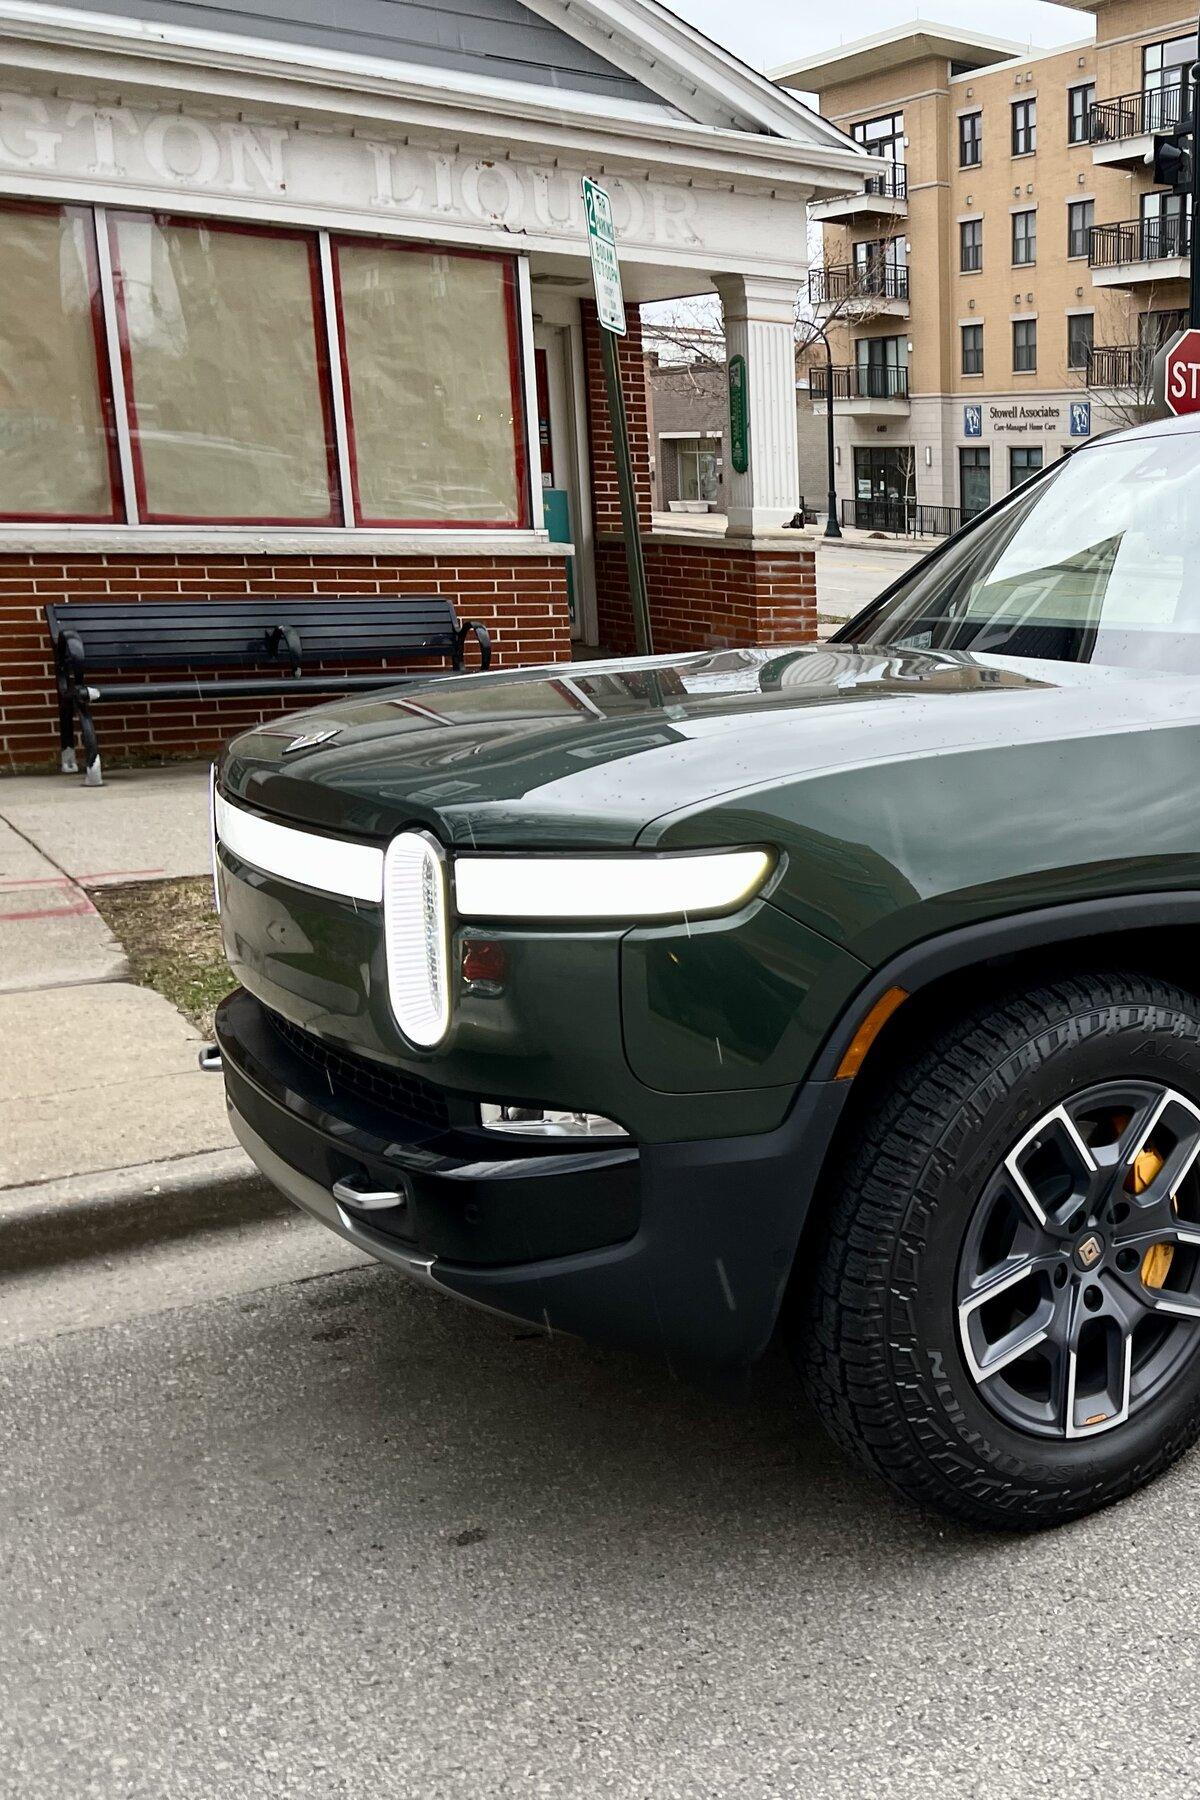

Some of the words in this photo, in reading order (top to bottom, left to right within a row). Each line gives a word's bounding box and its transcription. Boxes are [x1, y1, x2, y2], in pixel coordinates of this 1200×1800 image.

[366, 142, 703, 246] LIQUOR
[586, 190, 596, 228] 2
[989, 406, 1018, 419] Stowell
[1019, 405, 1060, 419] Associates
[1028, 423, 1043, 431] Home
[1044, 422, 1056, 431] Care
[1130, 1040, 1193, 1070] ALL
[926, 1349, 1075, 1485] SCORPION
